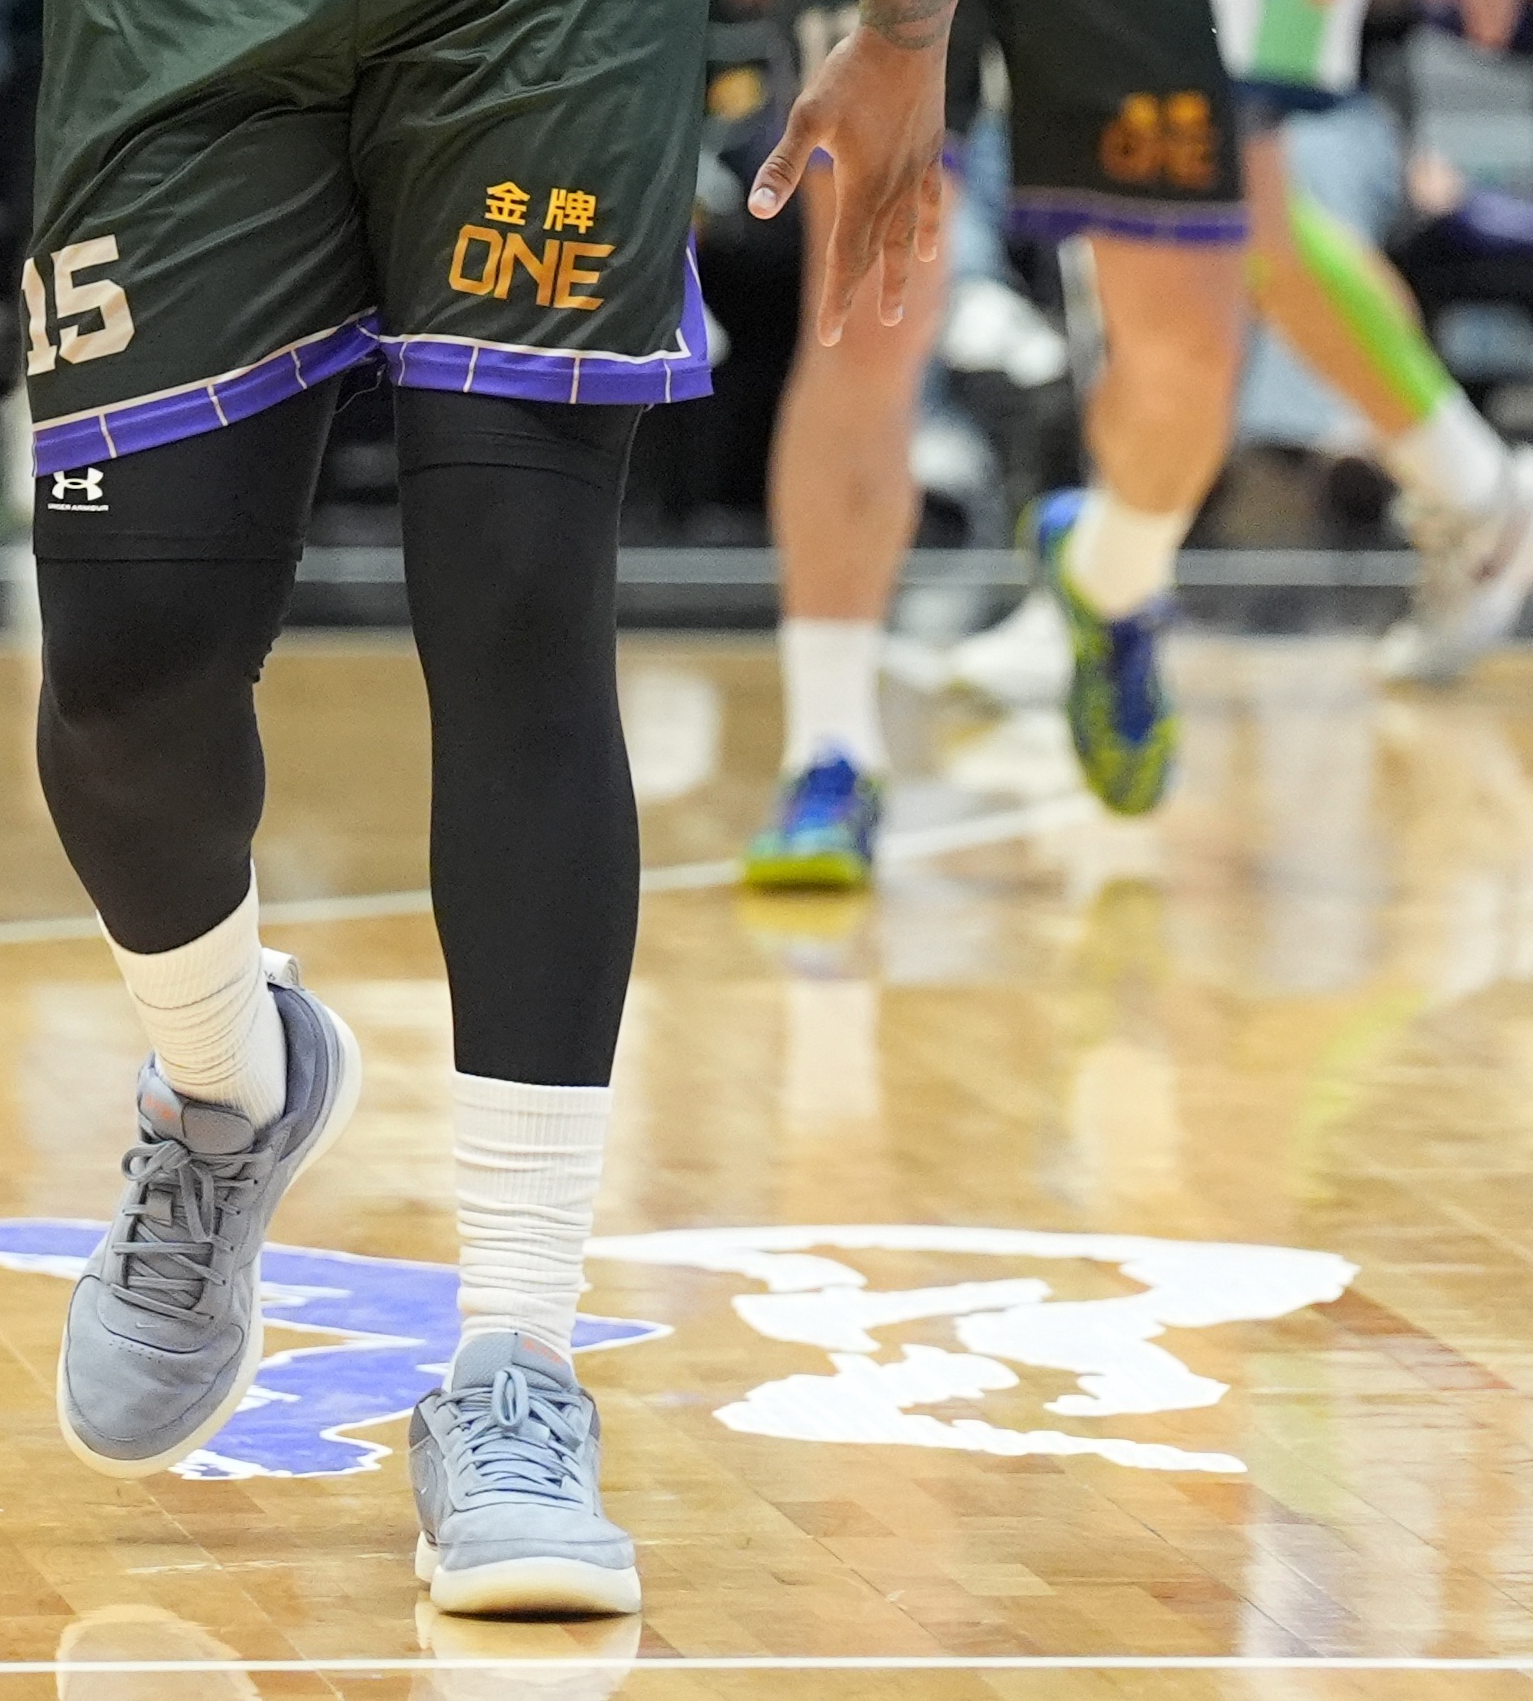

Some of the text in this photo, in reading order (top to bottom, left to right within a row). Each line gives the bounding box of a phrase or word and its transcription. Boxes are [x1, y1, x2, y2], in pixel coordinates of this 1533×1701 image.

[484, 181, 597, 235] 金牌
[20, 233, 136, 377] 15
[448, 223, 617, 311] ONE
